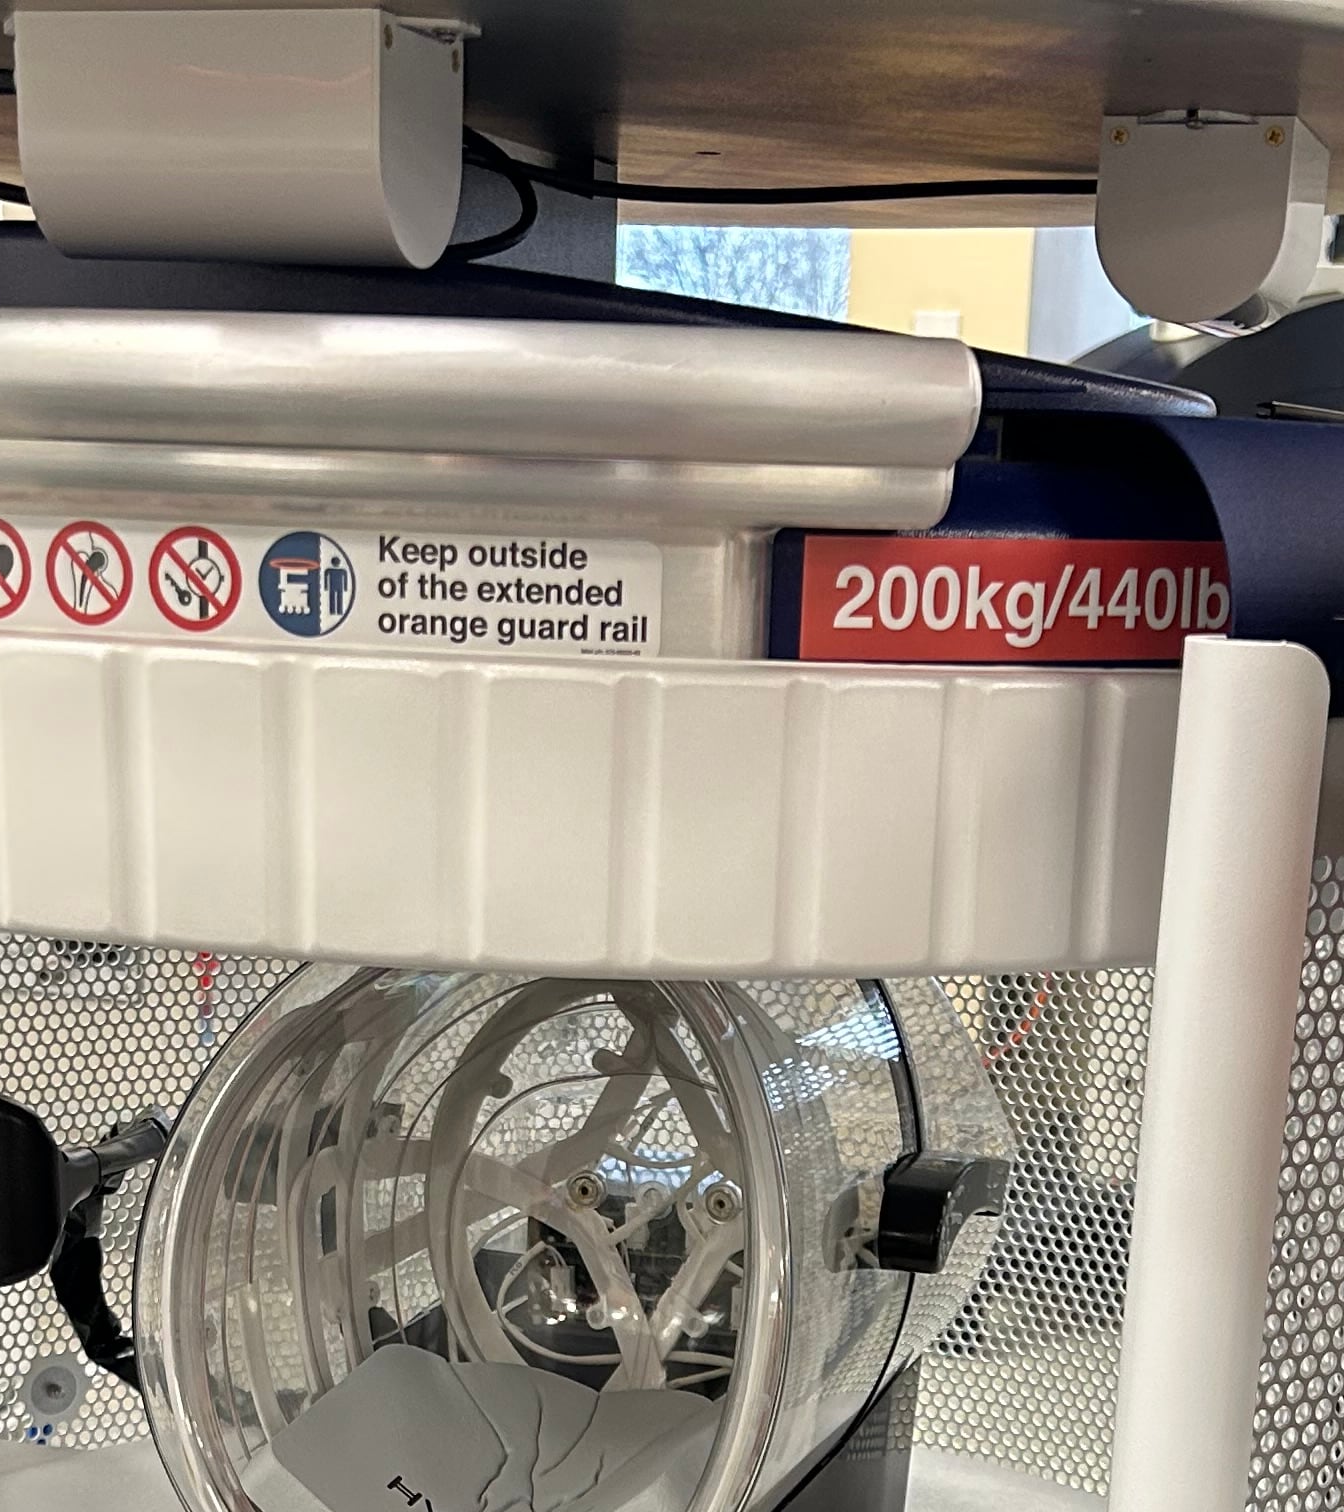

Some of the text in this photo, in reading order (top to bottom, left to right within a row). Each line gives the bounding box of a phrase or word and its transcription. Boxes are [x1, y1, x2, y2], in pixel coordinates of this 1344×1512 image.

[378, 535, 588, 571] Keep outside
[378, 572, 623, 607] of the extended
[833, 564, 1231, 649] 200kg/440lb
[378, 612, 648, 645] orange guard rail
